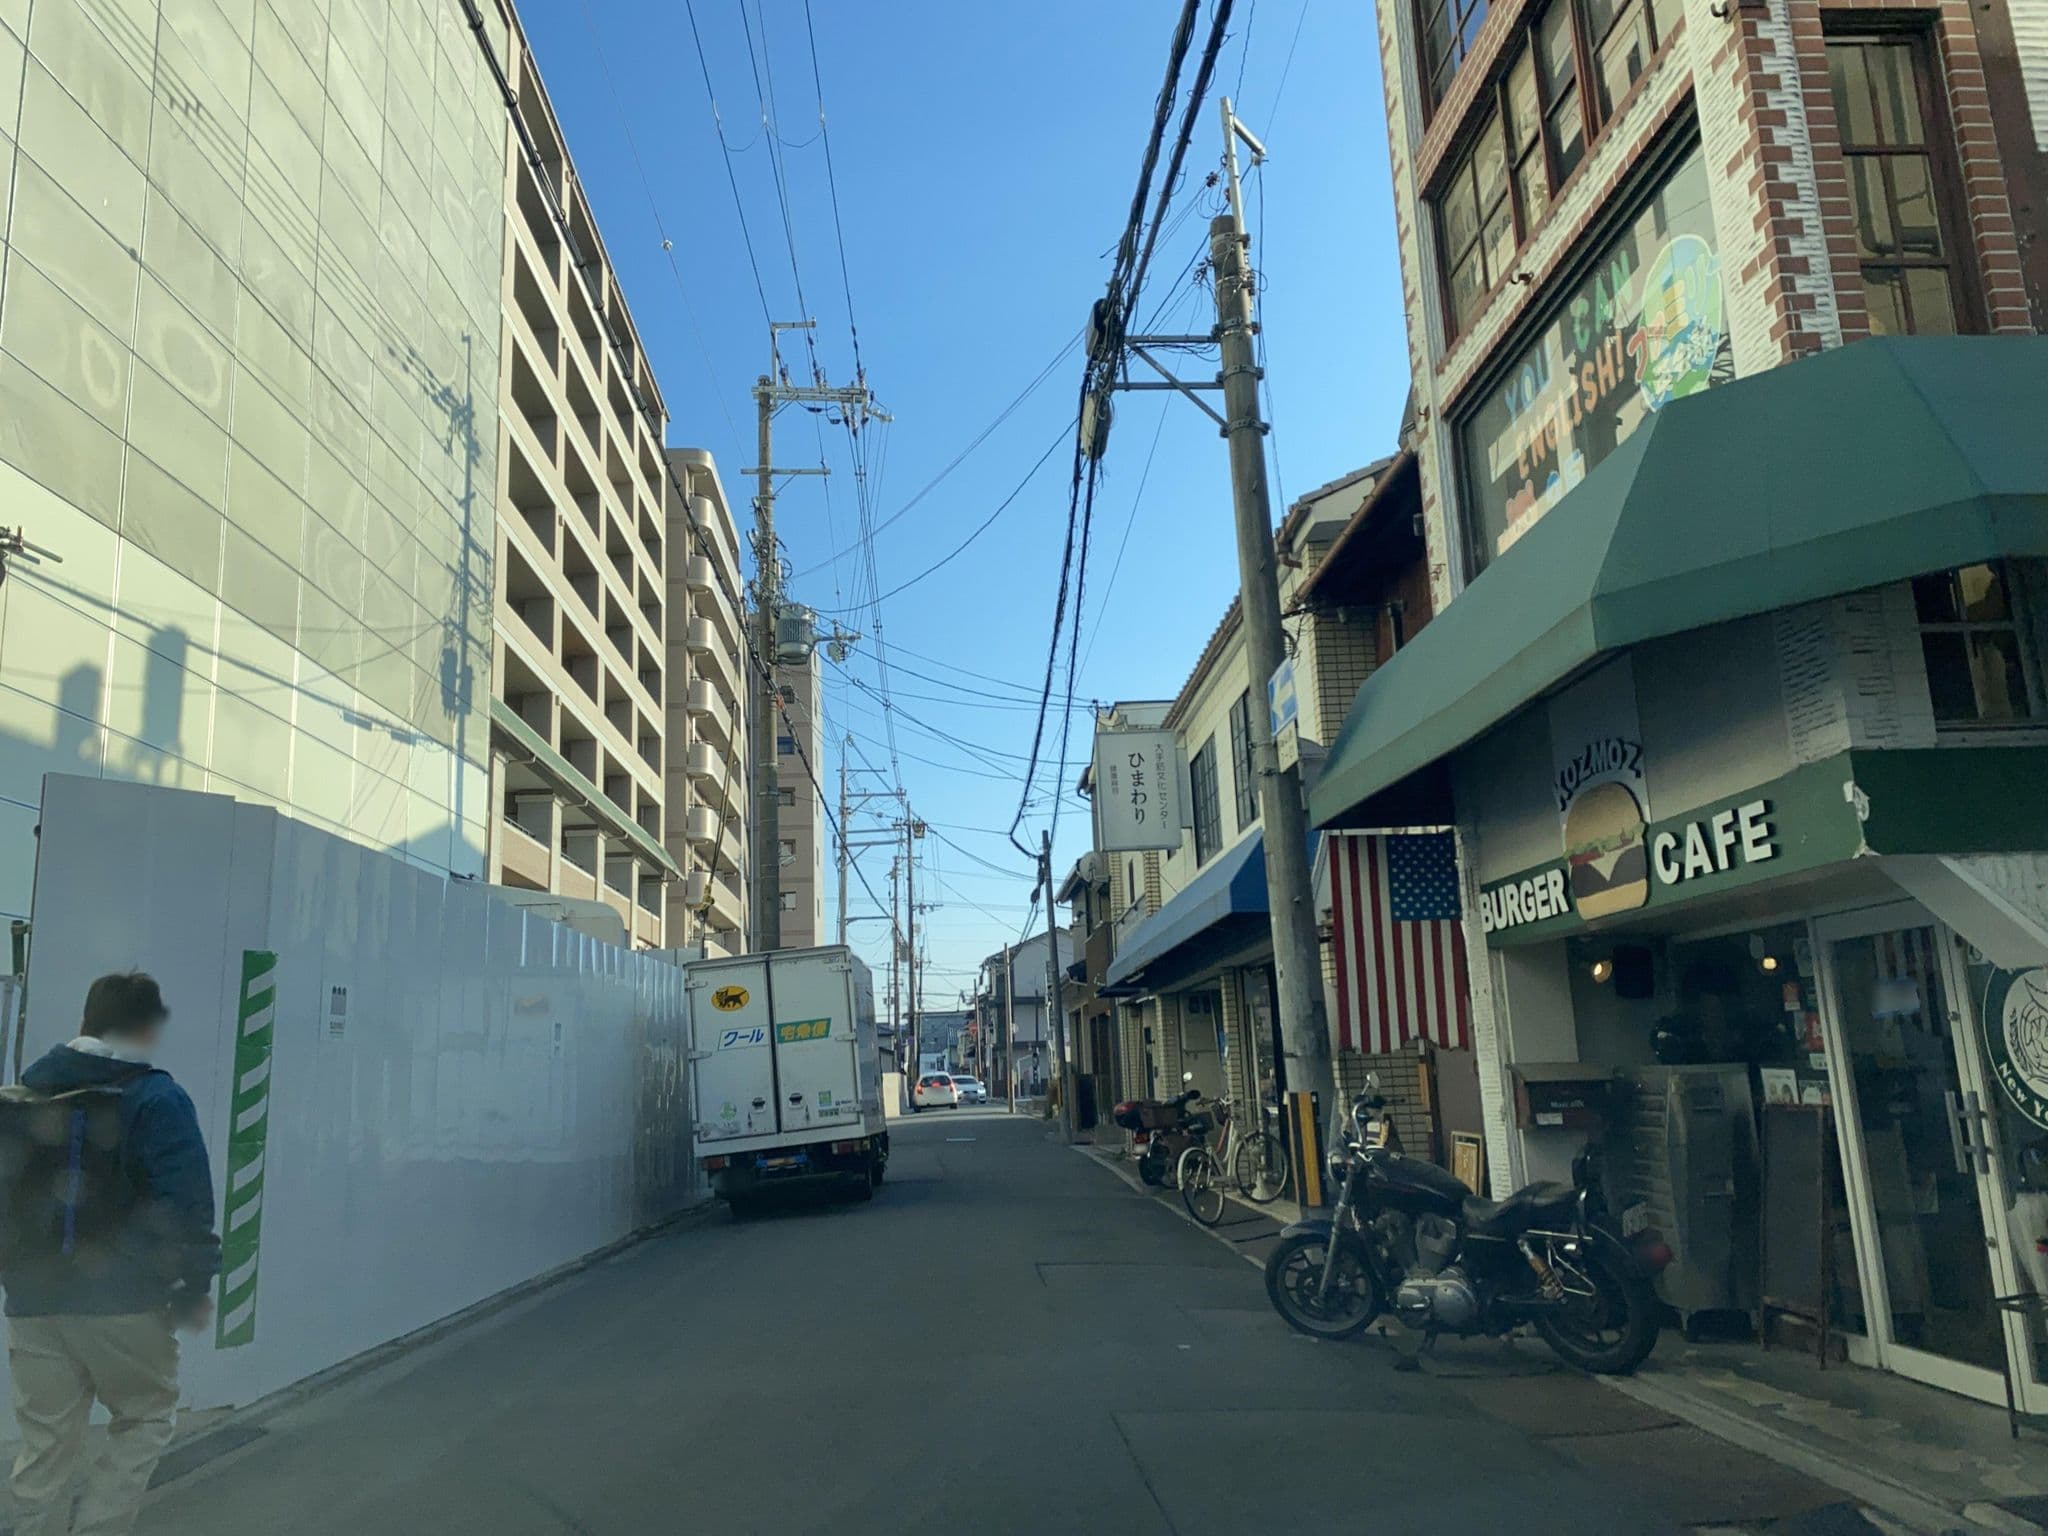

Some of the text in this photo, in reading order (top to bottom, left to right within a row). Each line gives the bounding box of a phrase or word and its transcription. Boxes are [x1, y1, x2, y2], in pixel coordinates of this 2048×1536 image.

[1505, 250, 1633, 430] YOU CAN
[1515, 328, 1625, 480] ENGLISH!
[1128, 752, 1147, 825] ひまわり
[1554, 736, 1644, 813] KOZMOZ
[1480, 799, 1773, 935] BURGER CAFE
[723, 1028, 765, 1048] クール
[1999, 1061, 2028, 1104] New
